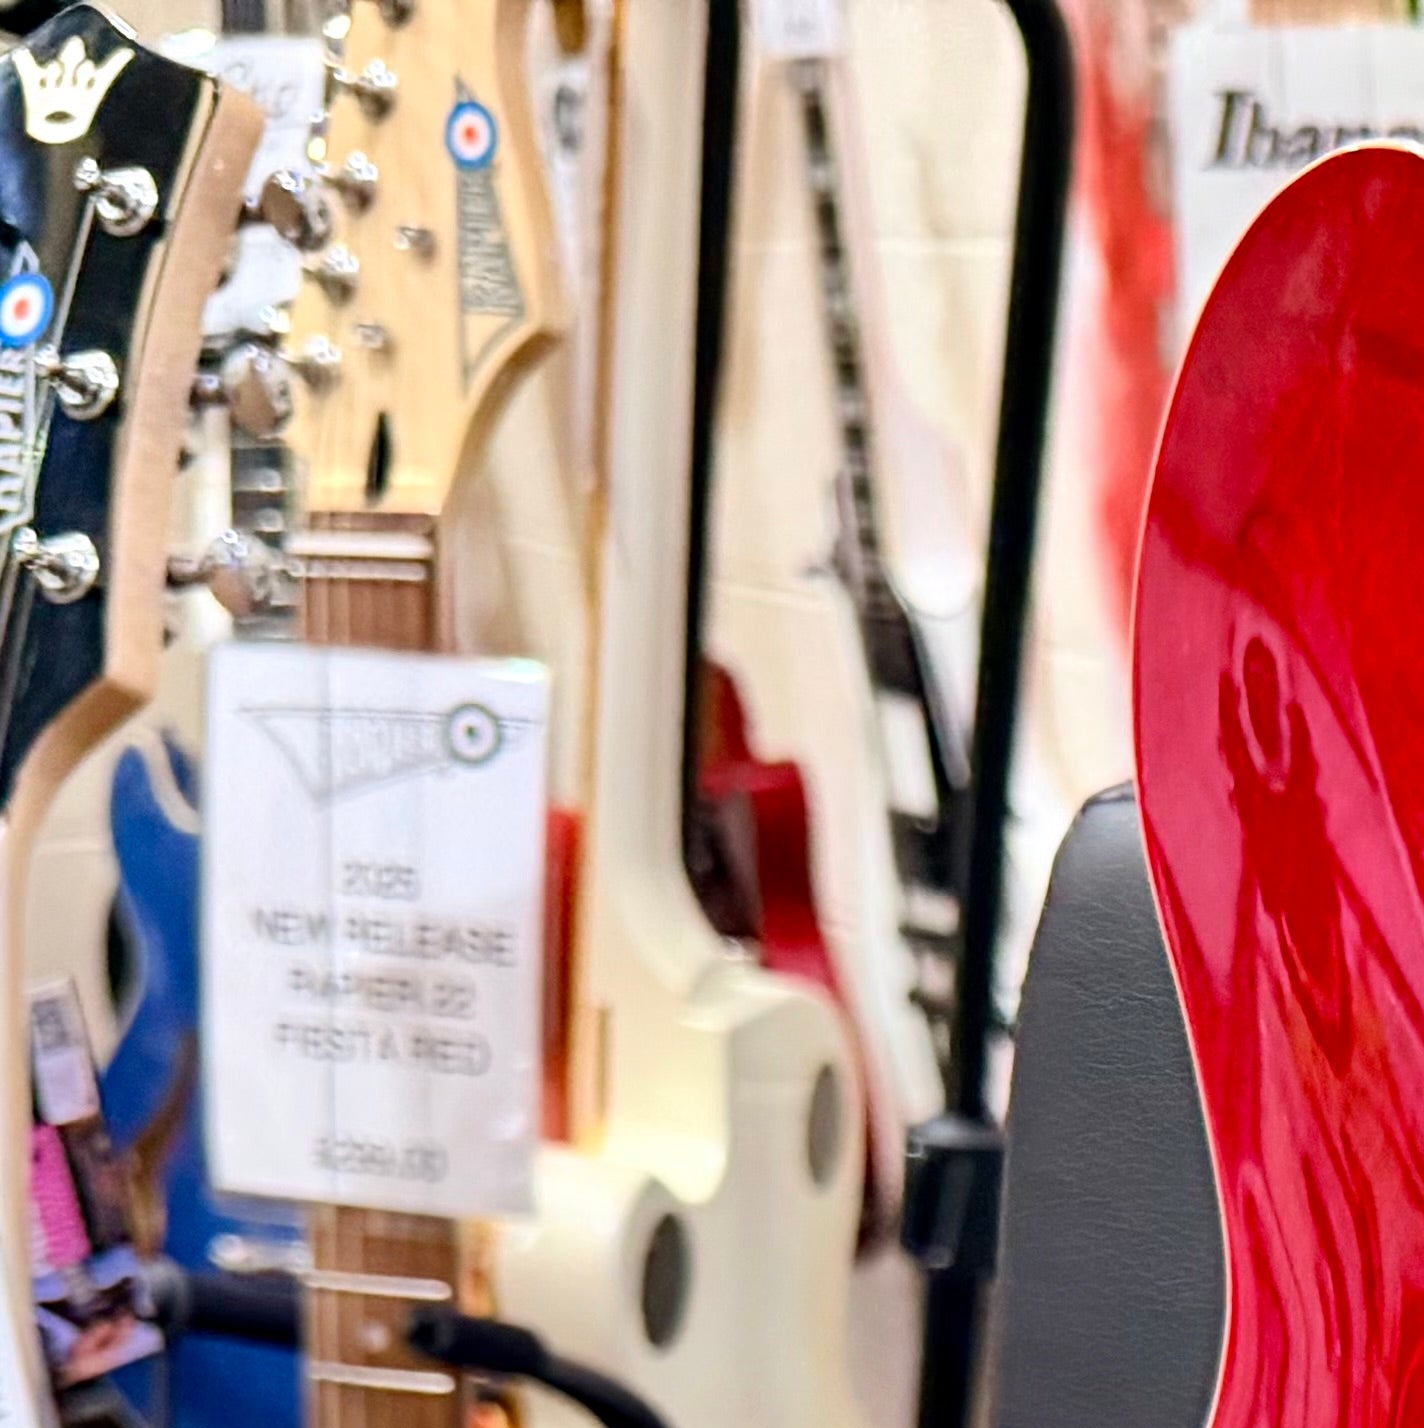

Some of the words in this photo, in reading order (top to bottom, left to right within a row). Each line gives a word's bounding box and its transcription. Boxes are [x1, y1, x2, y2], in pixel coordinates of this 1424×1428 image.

[252, 907, 328, 945] NEW
[344, 917, 518, 968] RELEASE
[289, 965, 422, 1012] RAPIER
[274, 1021, 398, 1062] FIESTA
[409, 1035, 493, 1077] RED
